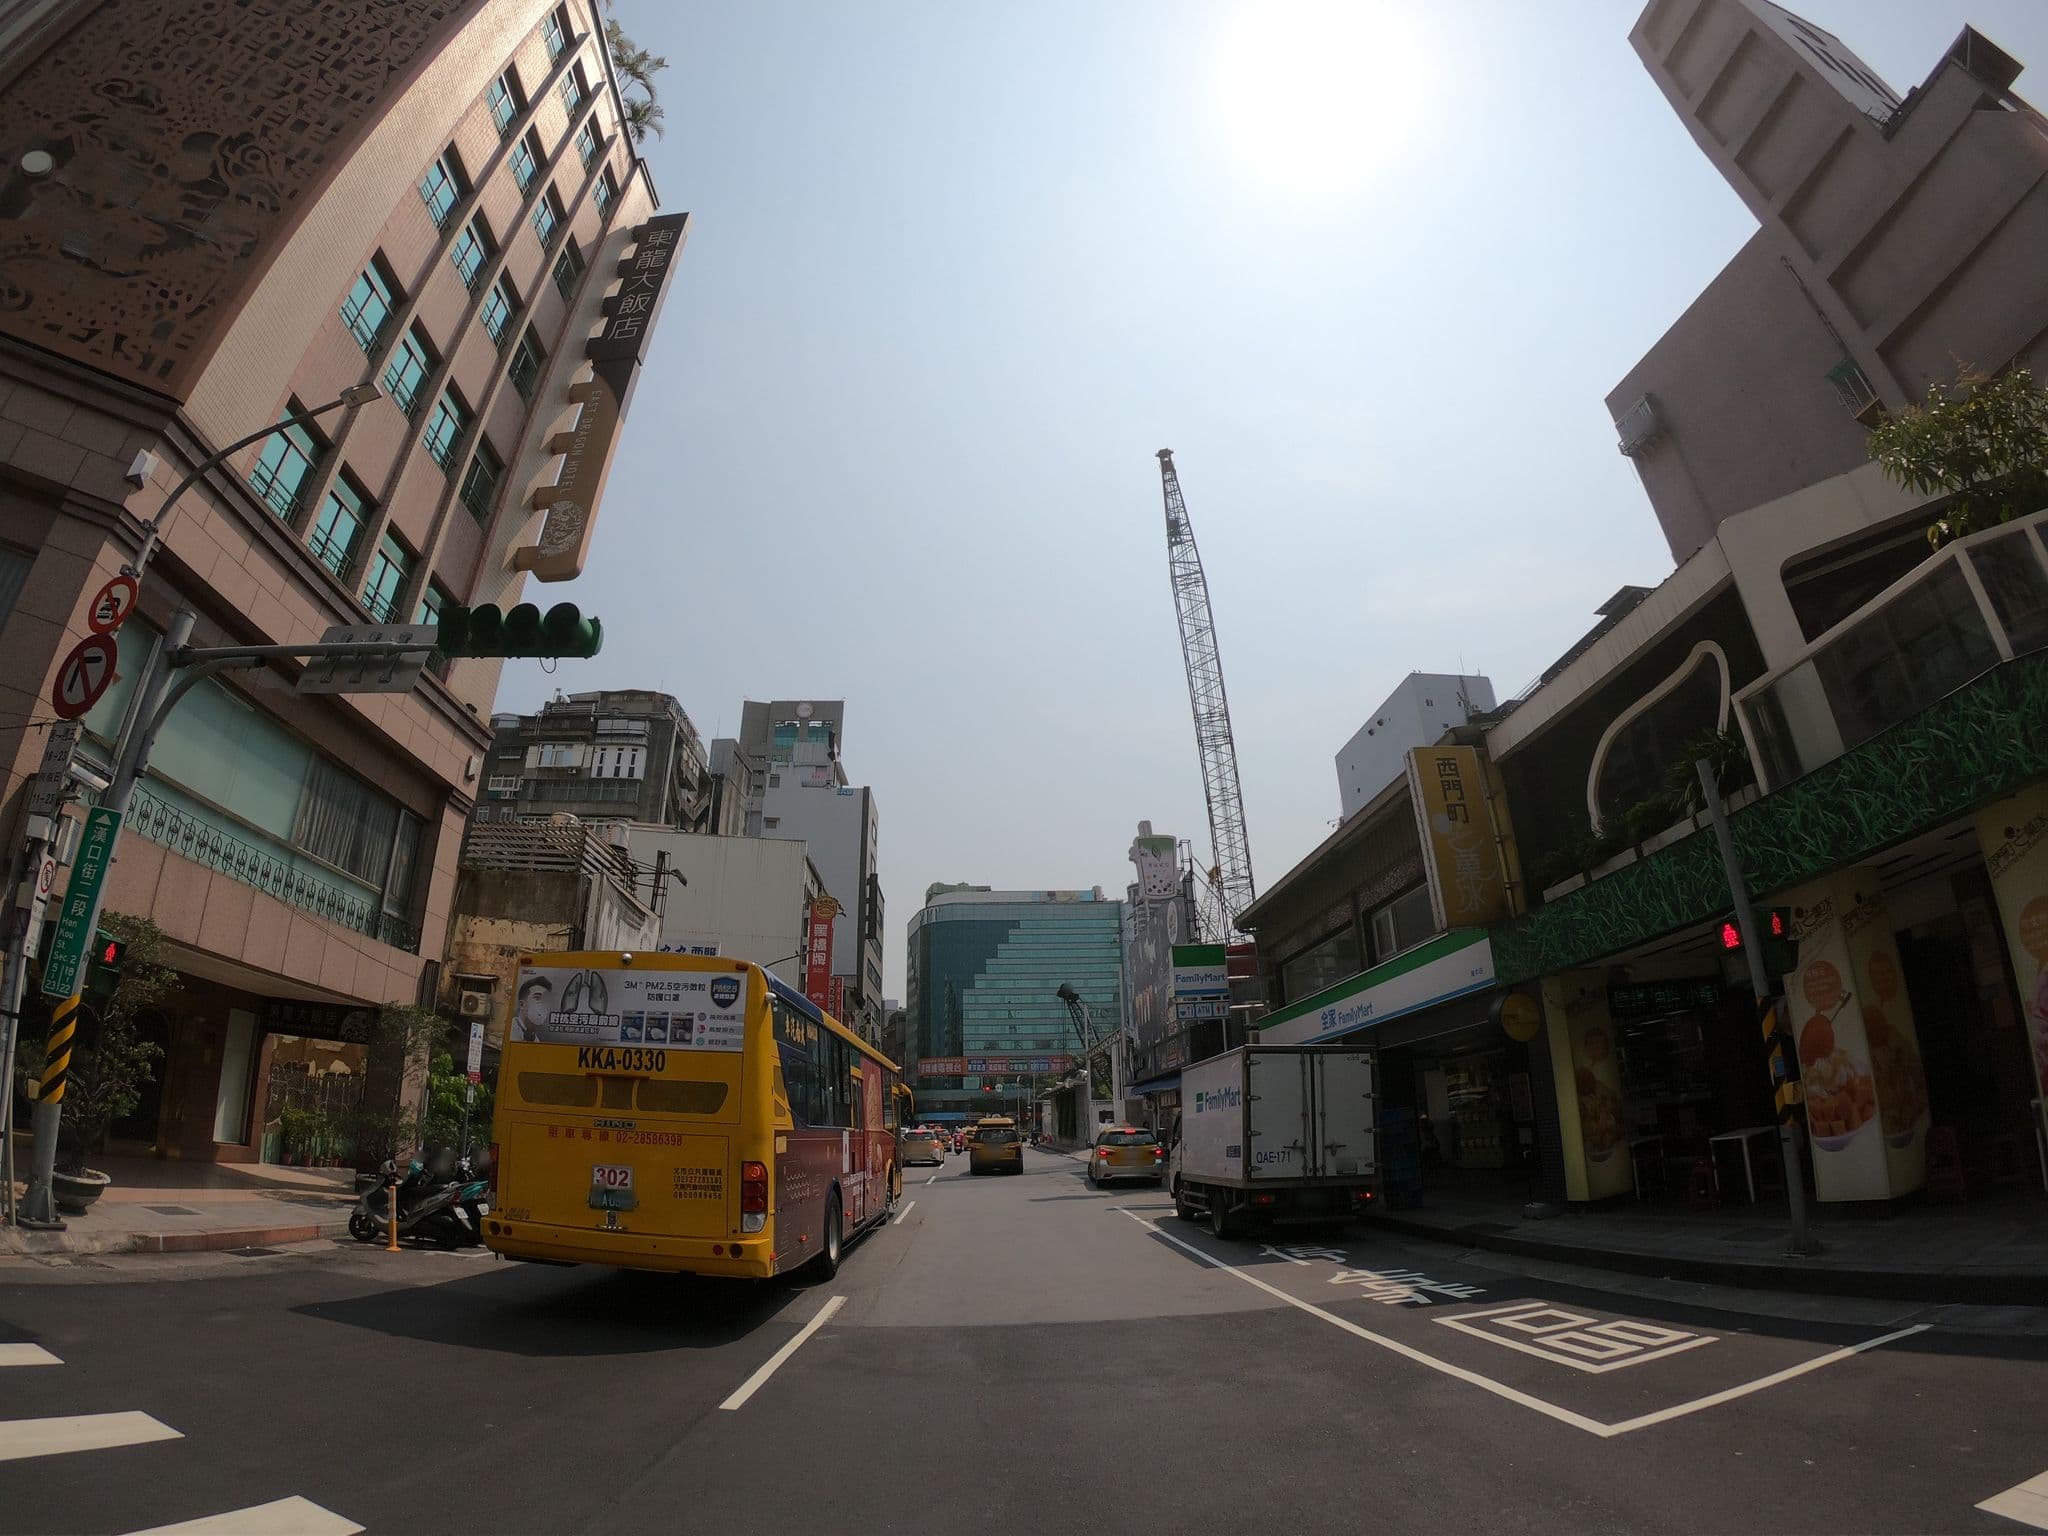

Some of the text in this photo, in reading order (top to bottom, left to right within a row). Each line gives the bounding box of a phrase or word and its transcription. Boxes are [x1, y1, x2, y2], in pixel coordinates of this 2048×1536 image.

[608, 229, 678, 341] 東龍大飯店
[559, 390, 602, 494] EAST DRAGON HOTEL
[71, 826, 109, 917] 漢口街二段
[62, 916, 78, 928] Han
[58, 928, 74, 940] Kou
[64, 966, 75, 977] 18
[1175, 973, 1226, 984] FamilyMart
[45, 979, 71, 994] 23 22
[1321, 1002, 1374, 1031] 全家 FamilyMart
[578, 1046, 666, 1072] KKA-0330
[1204, 1085, 1241, 1113] FamilyMart
[593, 1119, 637, 1130] HINO
[595, 1168, 629, 1187] 302
